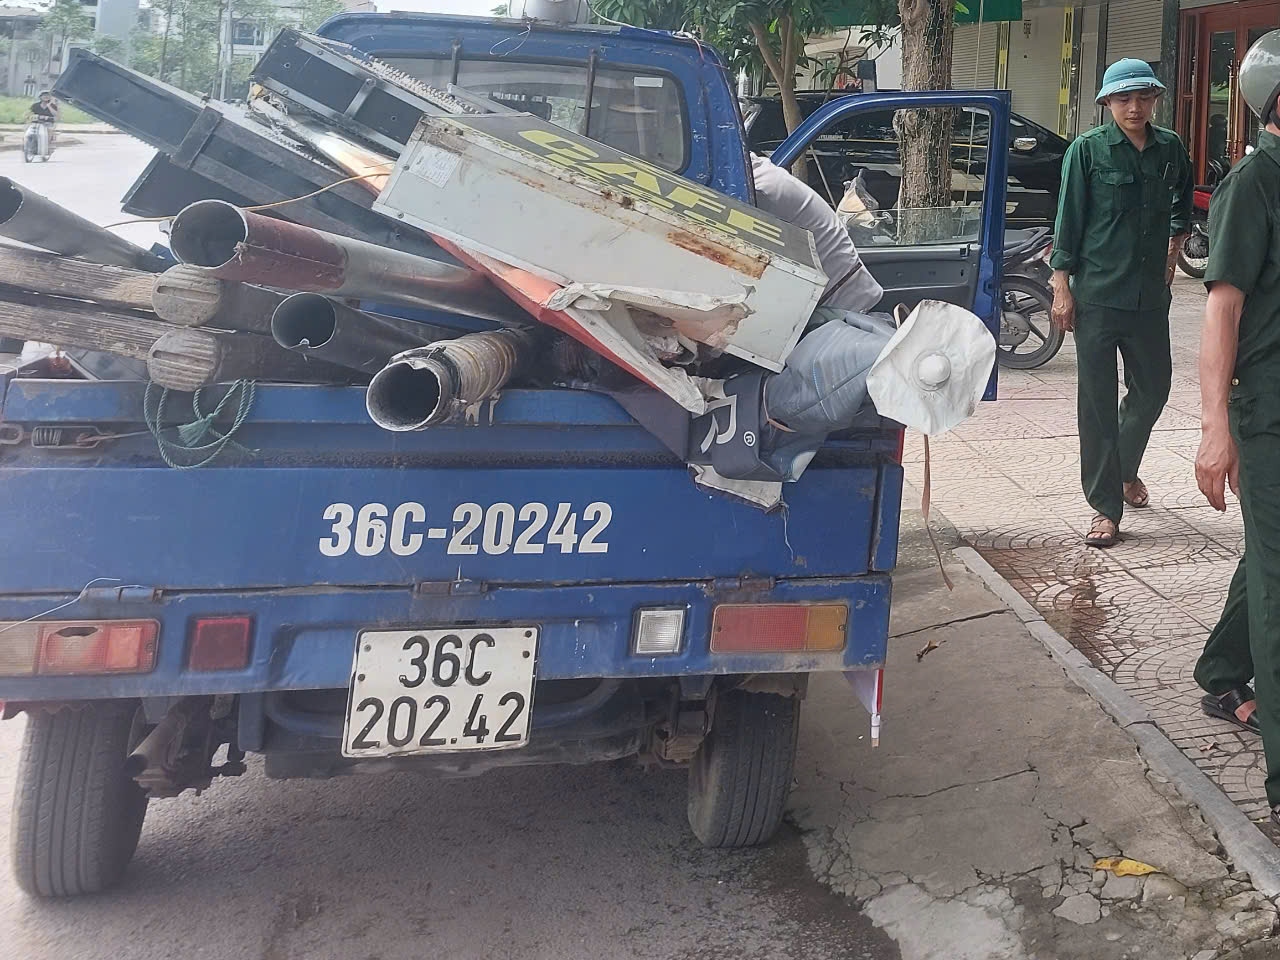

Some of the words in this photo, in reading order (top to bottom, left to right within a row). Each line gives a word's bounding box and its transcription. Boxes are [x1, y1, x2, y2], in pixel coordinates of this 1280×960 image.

[518, 130, 786, 247] CAFE
[319, 501, 613, 557] 36C-20242
[398, 633, 496, 688] 36C
[352, 691, 525, 750] 202.42
